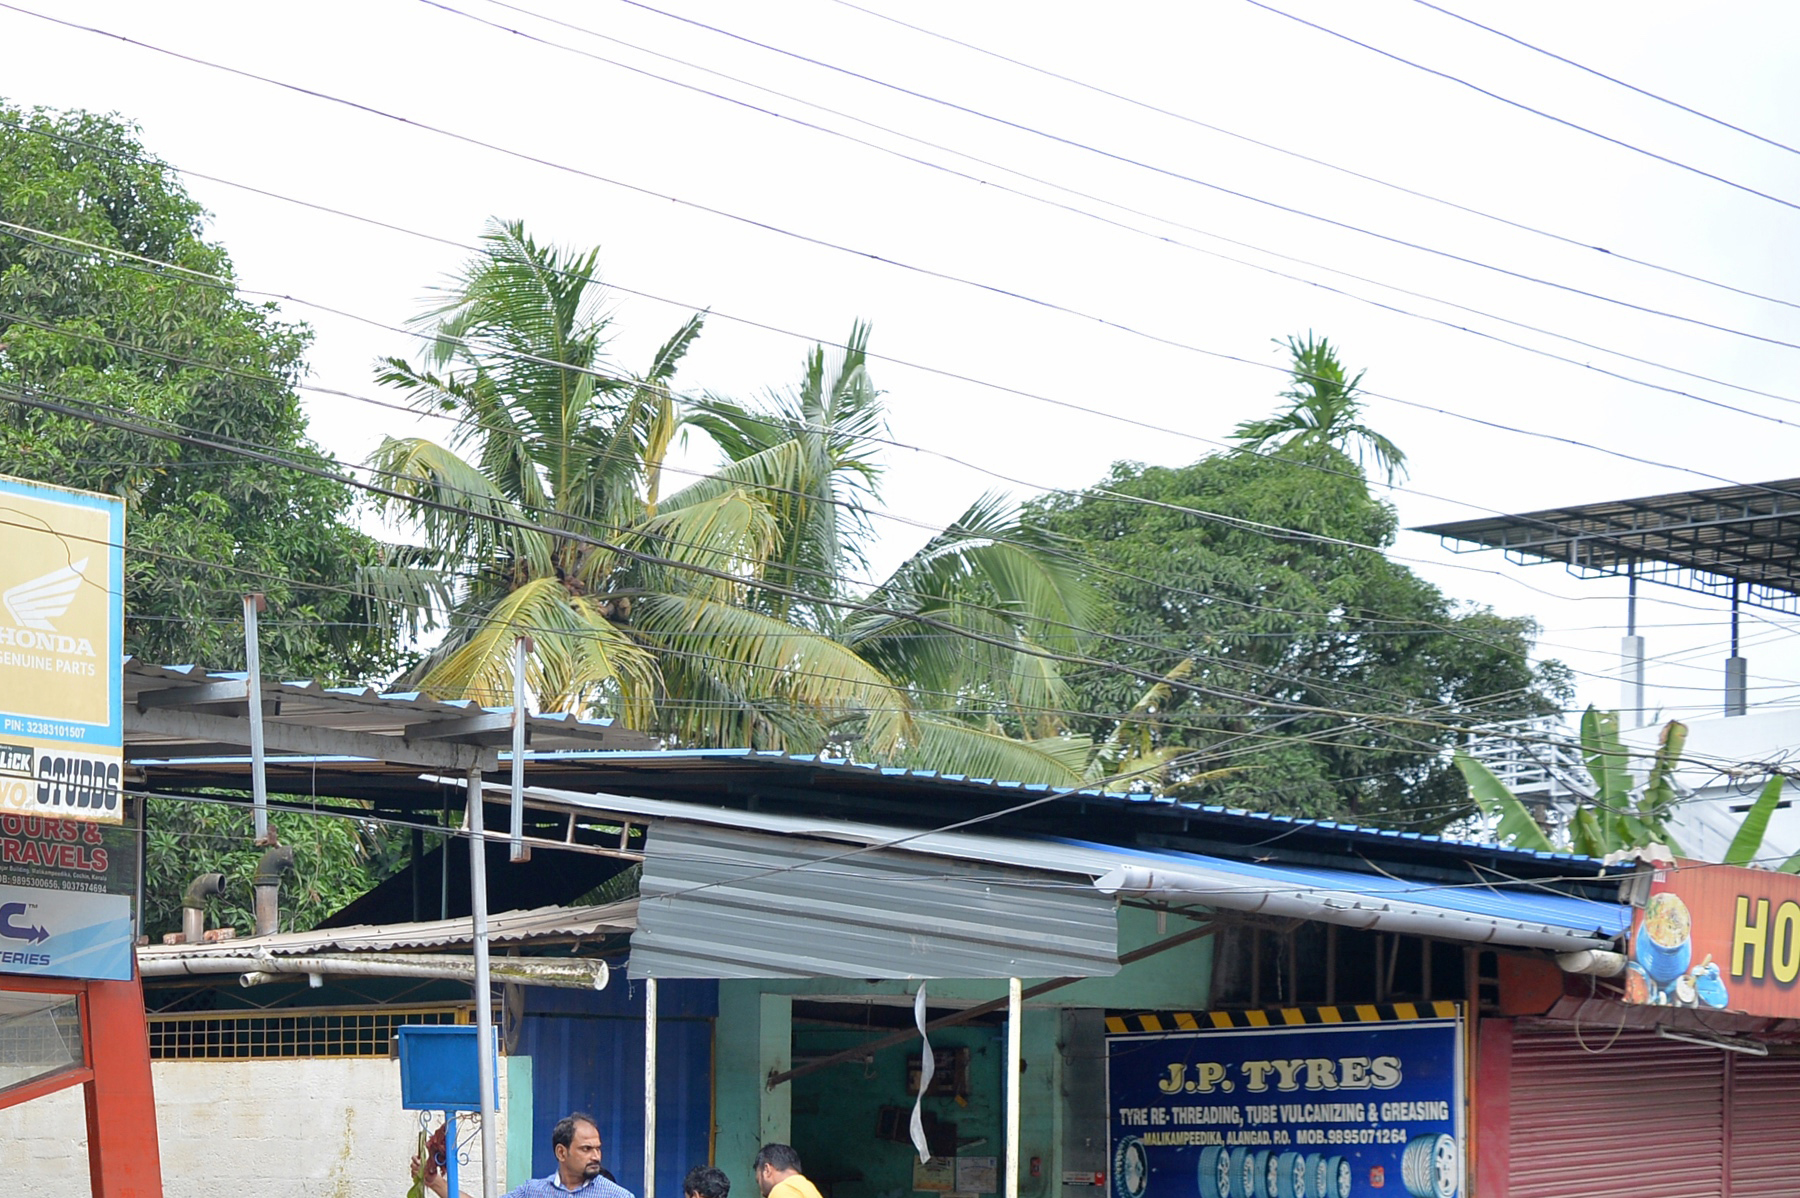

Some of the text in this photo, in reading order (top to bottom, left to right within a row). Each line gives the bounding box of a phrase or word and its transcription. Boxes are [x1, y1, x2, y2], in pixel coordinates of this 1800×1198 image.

[56, 659, 95, 676] PARTS
[4, 719, 86, 738] PIN: 32383101507
[37, 756, 119, 810] STUDDS
[82, 821, 103, 843] &
[62, 881, 107, 893] 9037574694
[1731, 896, 1800, 984] HO
[1159, 1056, 1403, 1095] J.P. TYRES
[1119, 1107, 1149, 1126] TYRE
[1171, 1105, 1244, 1128] THREADING,
[1246, 1104, 1279, 1124] TUBE
[1280, 1103, 1365, 1124] VULCANIZING
[1368, 1102, 1378, 1121] &
[1381, 1101, 1449, 1122] GREASING
[1144, 1131, 1225, 1147] MALIKAMPEEDIKA,
